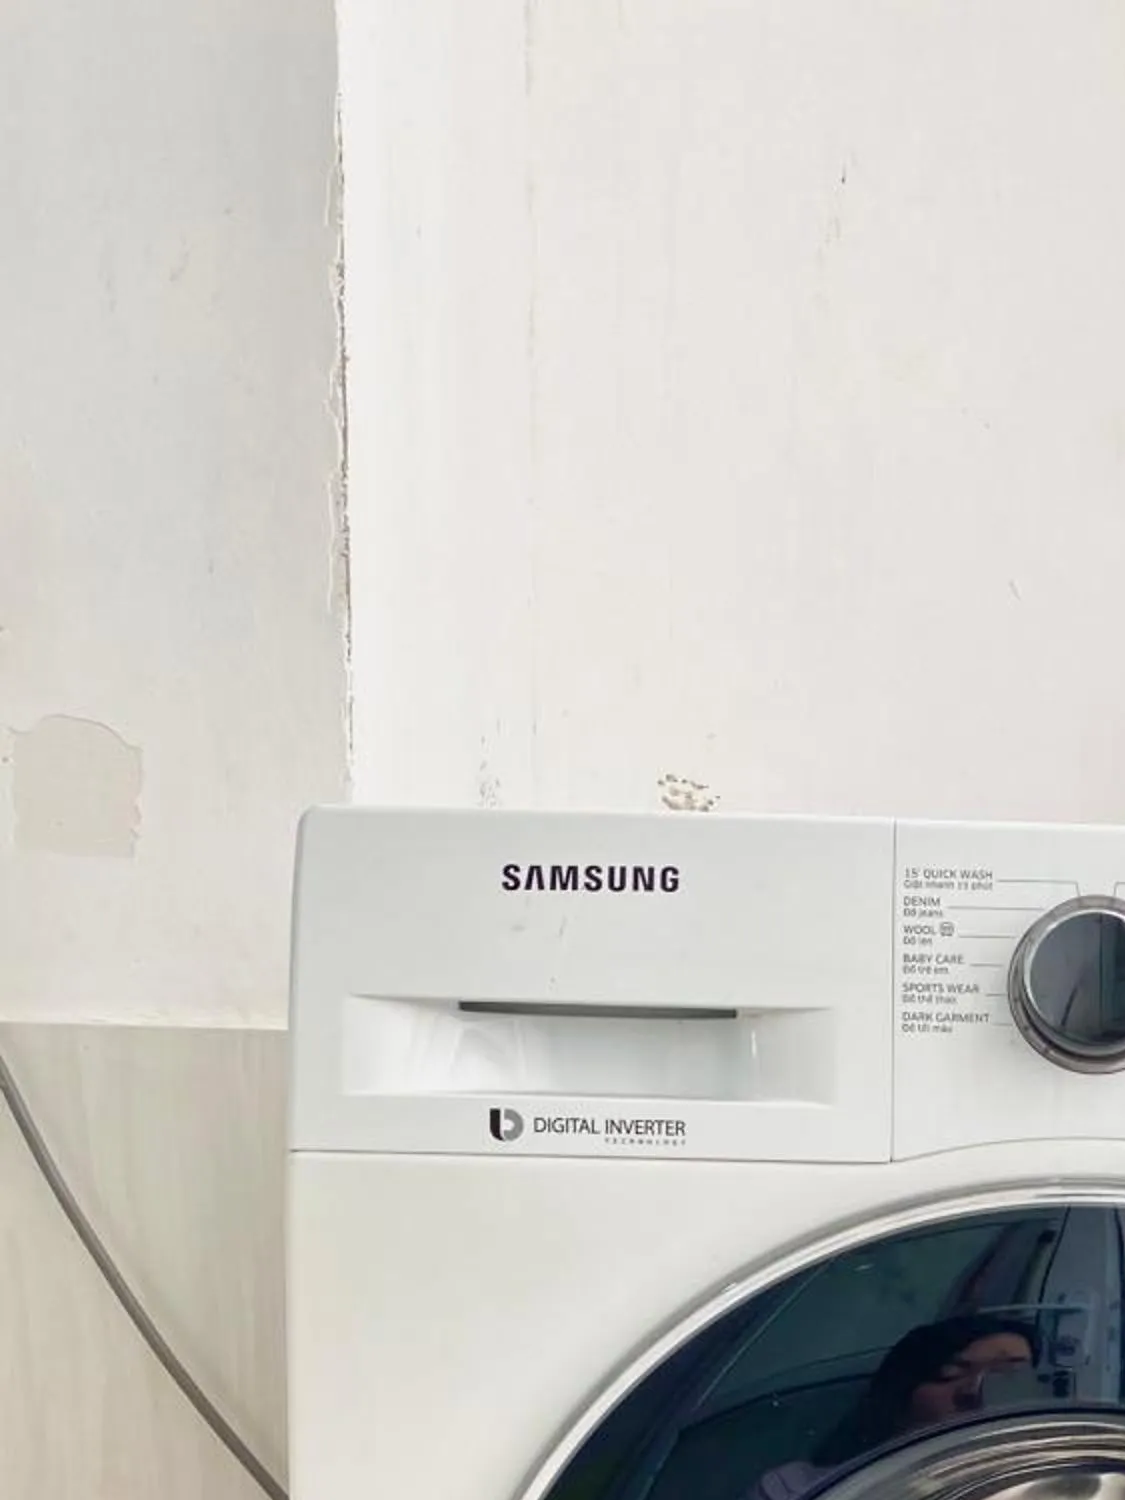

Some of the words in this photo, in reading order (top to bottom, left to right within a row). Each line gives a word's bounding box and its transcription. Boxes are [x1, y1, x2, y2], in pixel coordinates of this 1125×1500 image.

[502, 864, 679, 892] SAMSUNG
[923, 869, 957, 879] QUICK
[960, 869, 993, 880] WASH
[903, 896, 941, 907] DENIM
[903, 925, 937, 935] WOOL
[935, 954, 964, 964] CARE
[902, 982, 944, 993] SPORTS
[946, 984, 980, 993] WEAR
[902, 1011, 932, 1022] DARK
[935, 1012, 989, 1023] GARMENT
[533, 1117, 600, 1135] DIGITAL
[605, 1119, 686, 1137] INVERTER
